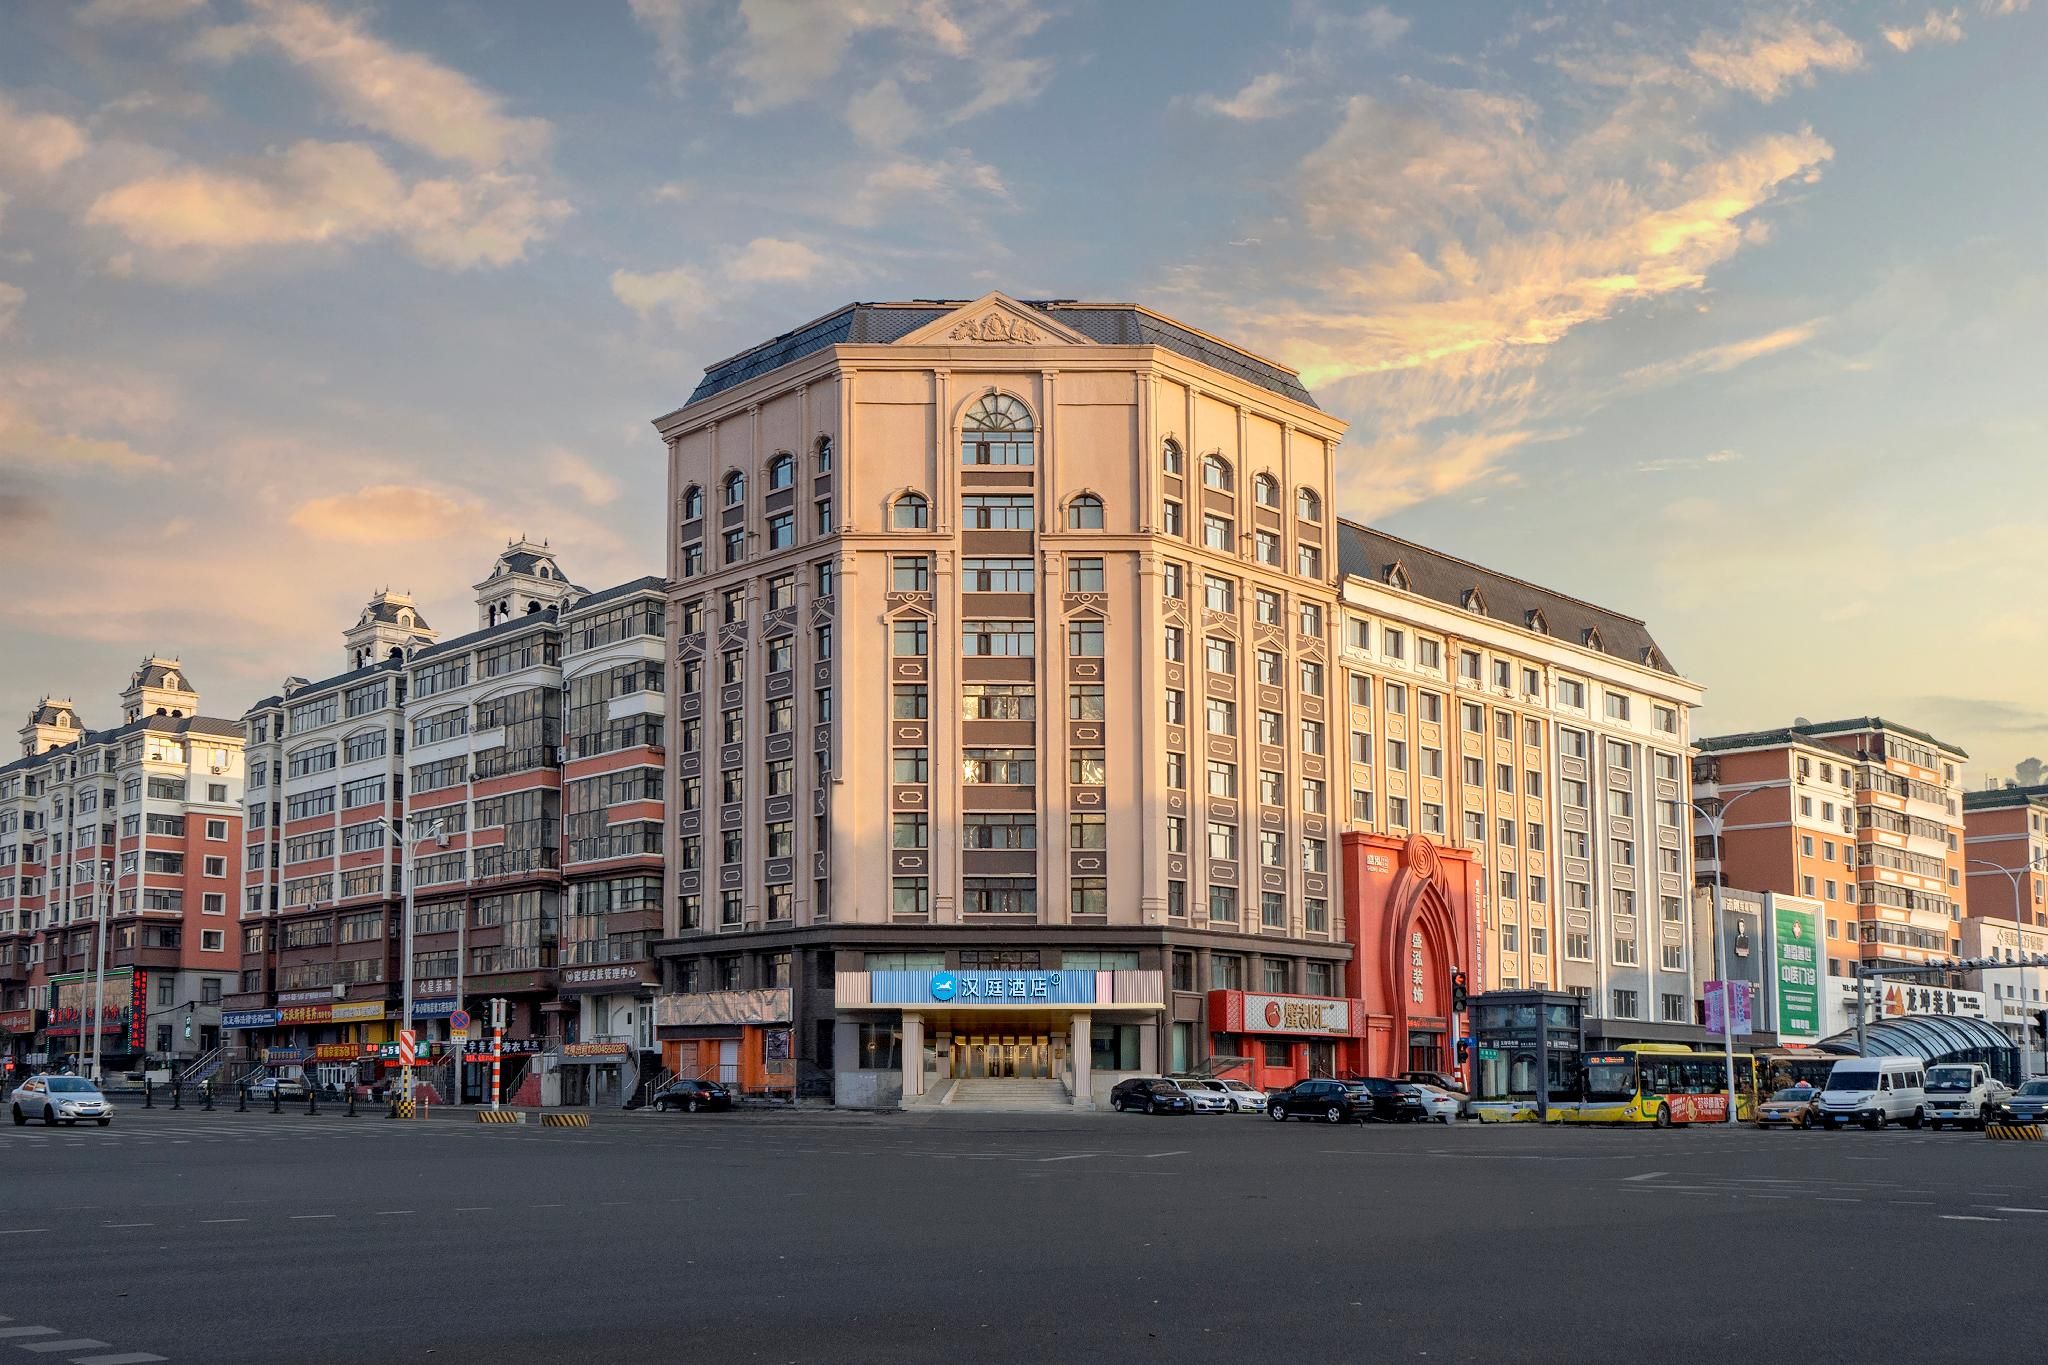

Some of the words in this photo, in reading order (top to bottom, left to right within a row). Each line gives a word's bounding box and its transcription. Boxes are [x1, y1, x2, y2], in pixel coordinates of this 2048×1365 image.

[1412, 932, 1423, 1004] 盛泓装饰
[1781, 965, 1816, 986] 中医门诊
[418, 979, 452, 994] 众星装饰
[961, 978, 1047, 997] 汉庭酒店
[1907, 987, 1956, 1015] 龙坤装饰
